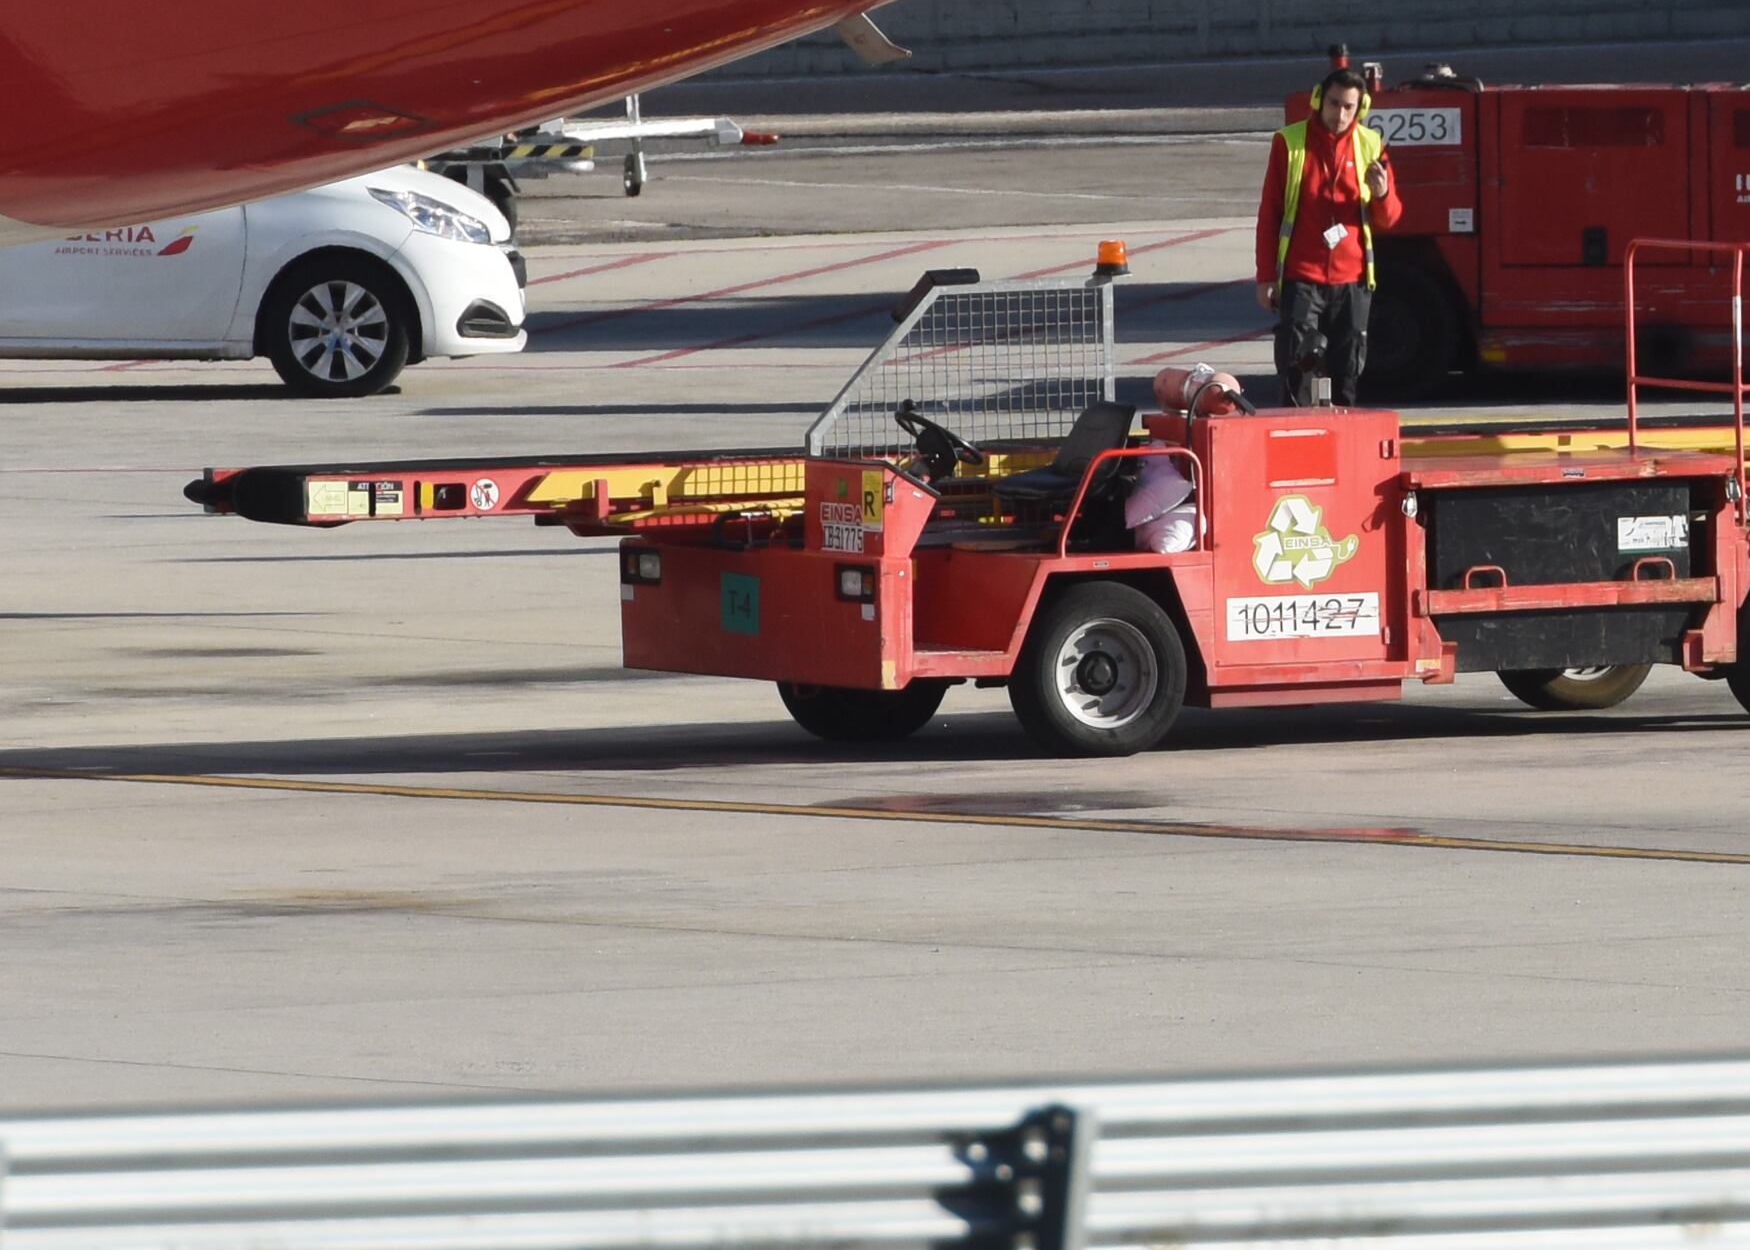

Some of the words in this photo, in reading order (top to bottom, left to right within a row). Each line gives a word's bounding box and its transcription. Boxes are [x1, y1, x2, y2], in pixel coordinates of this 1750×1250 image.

[54, 246, 99, 255] AIRPORT
[103, 247, 152, 256] SERVICES
[821, 503, 862, 523] EINSA
[864, 491, 876, 517] R
[1285, 536, 1332, 549] EINSA
[1238, 598, 1365, 635] 1011427
